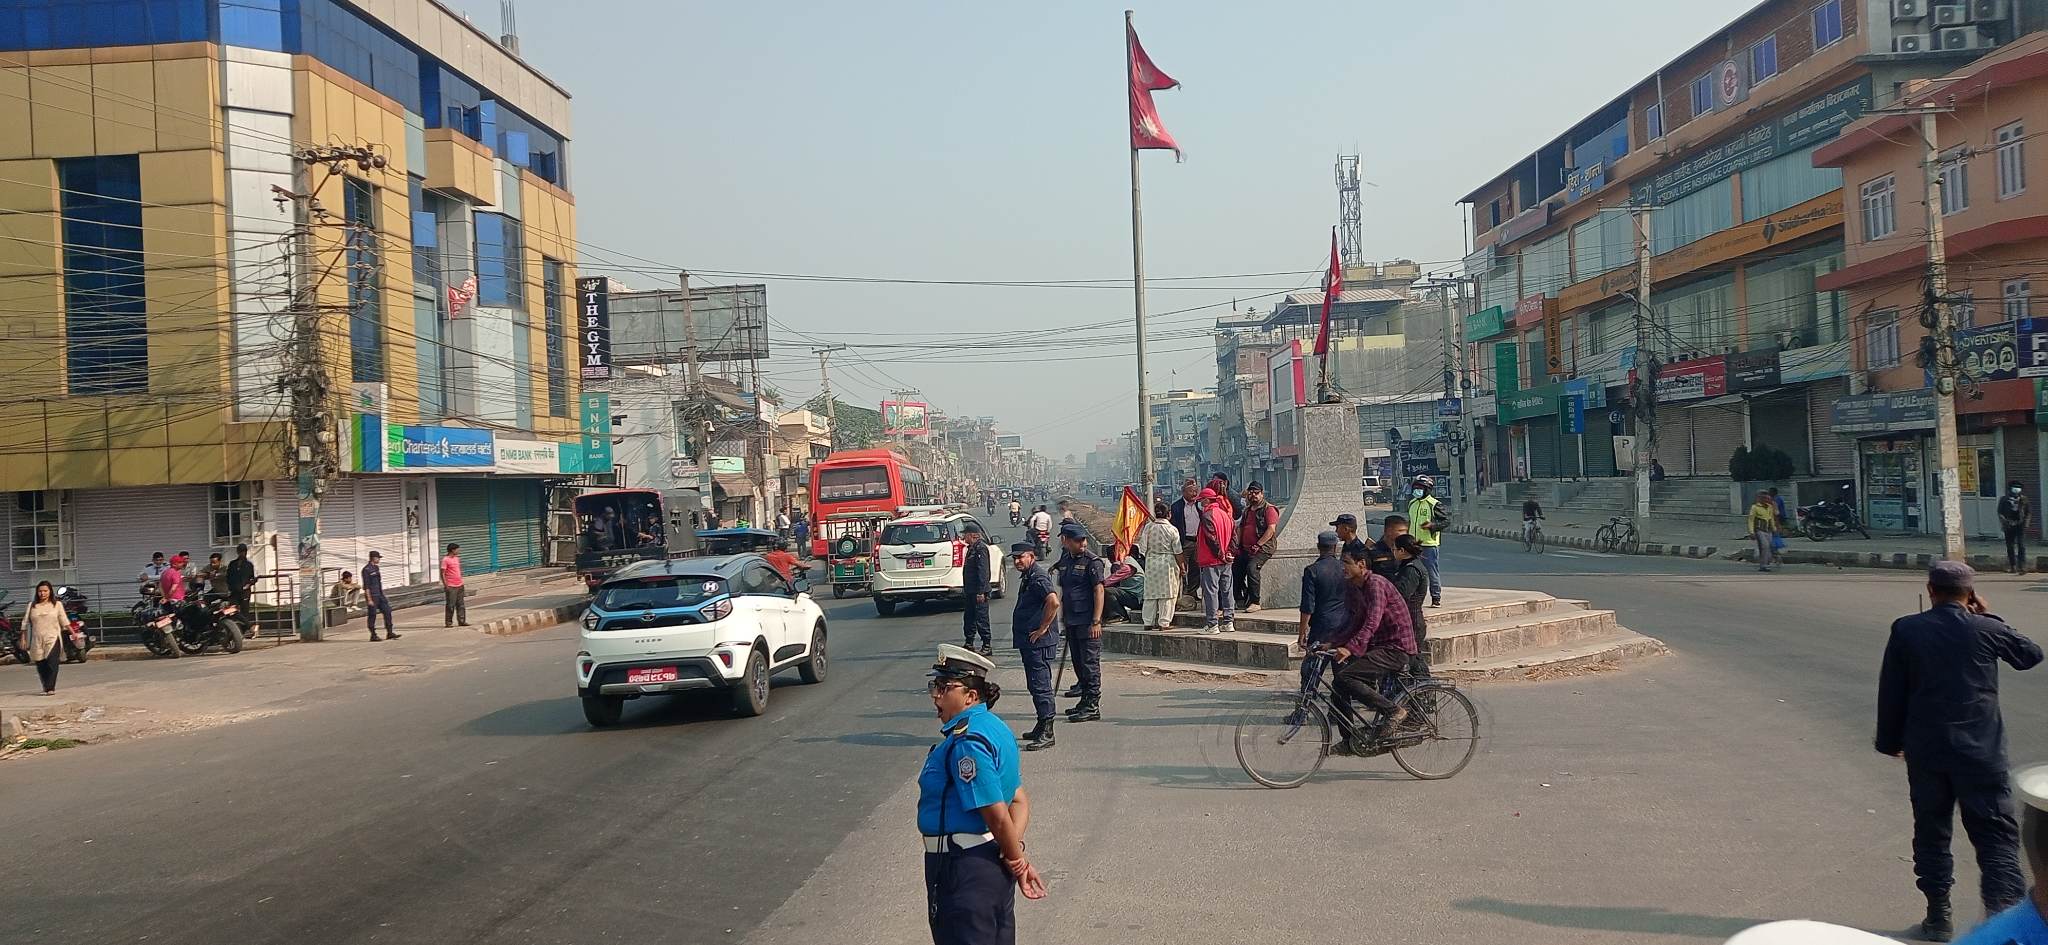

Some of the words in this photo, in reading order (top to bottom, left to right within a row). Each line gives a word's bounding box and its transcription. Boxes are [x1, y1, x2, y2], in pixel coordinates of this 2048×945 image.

[585, 292, 599, 328] THE
[586, 331, 602, 366] GYM
[402, 438, 440, 454] Chartered
[518, 449, 532, 460] BANK
